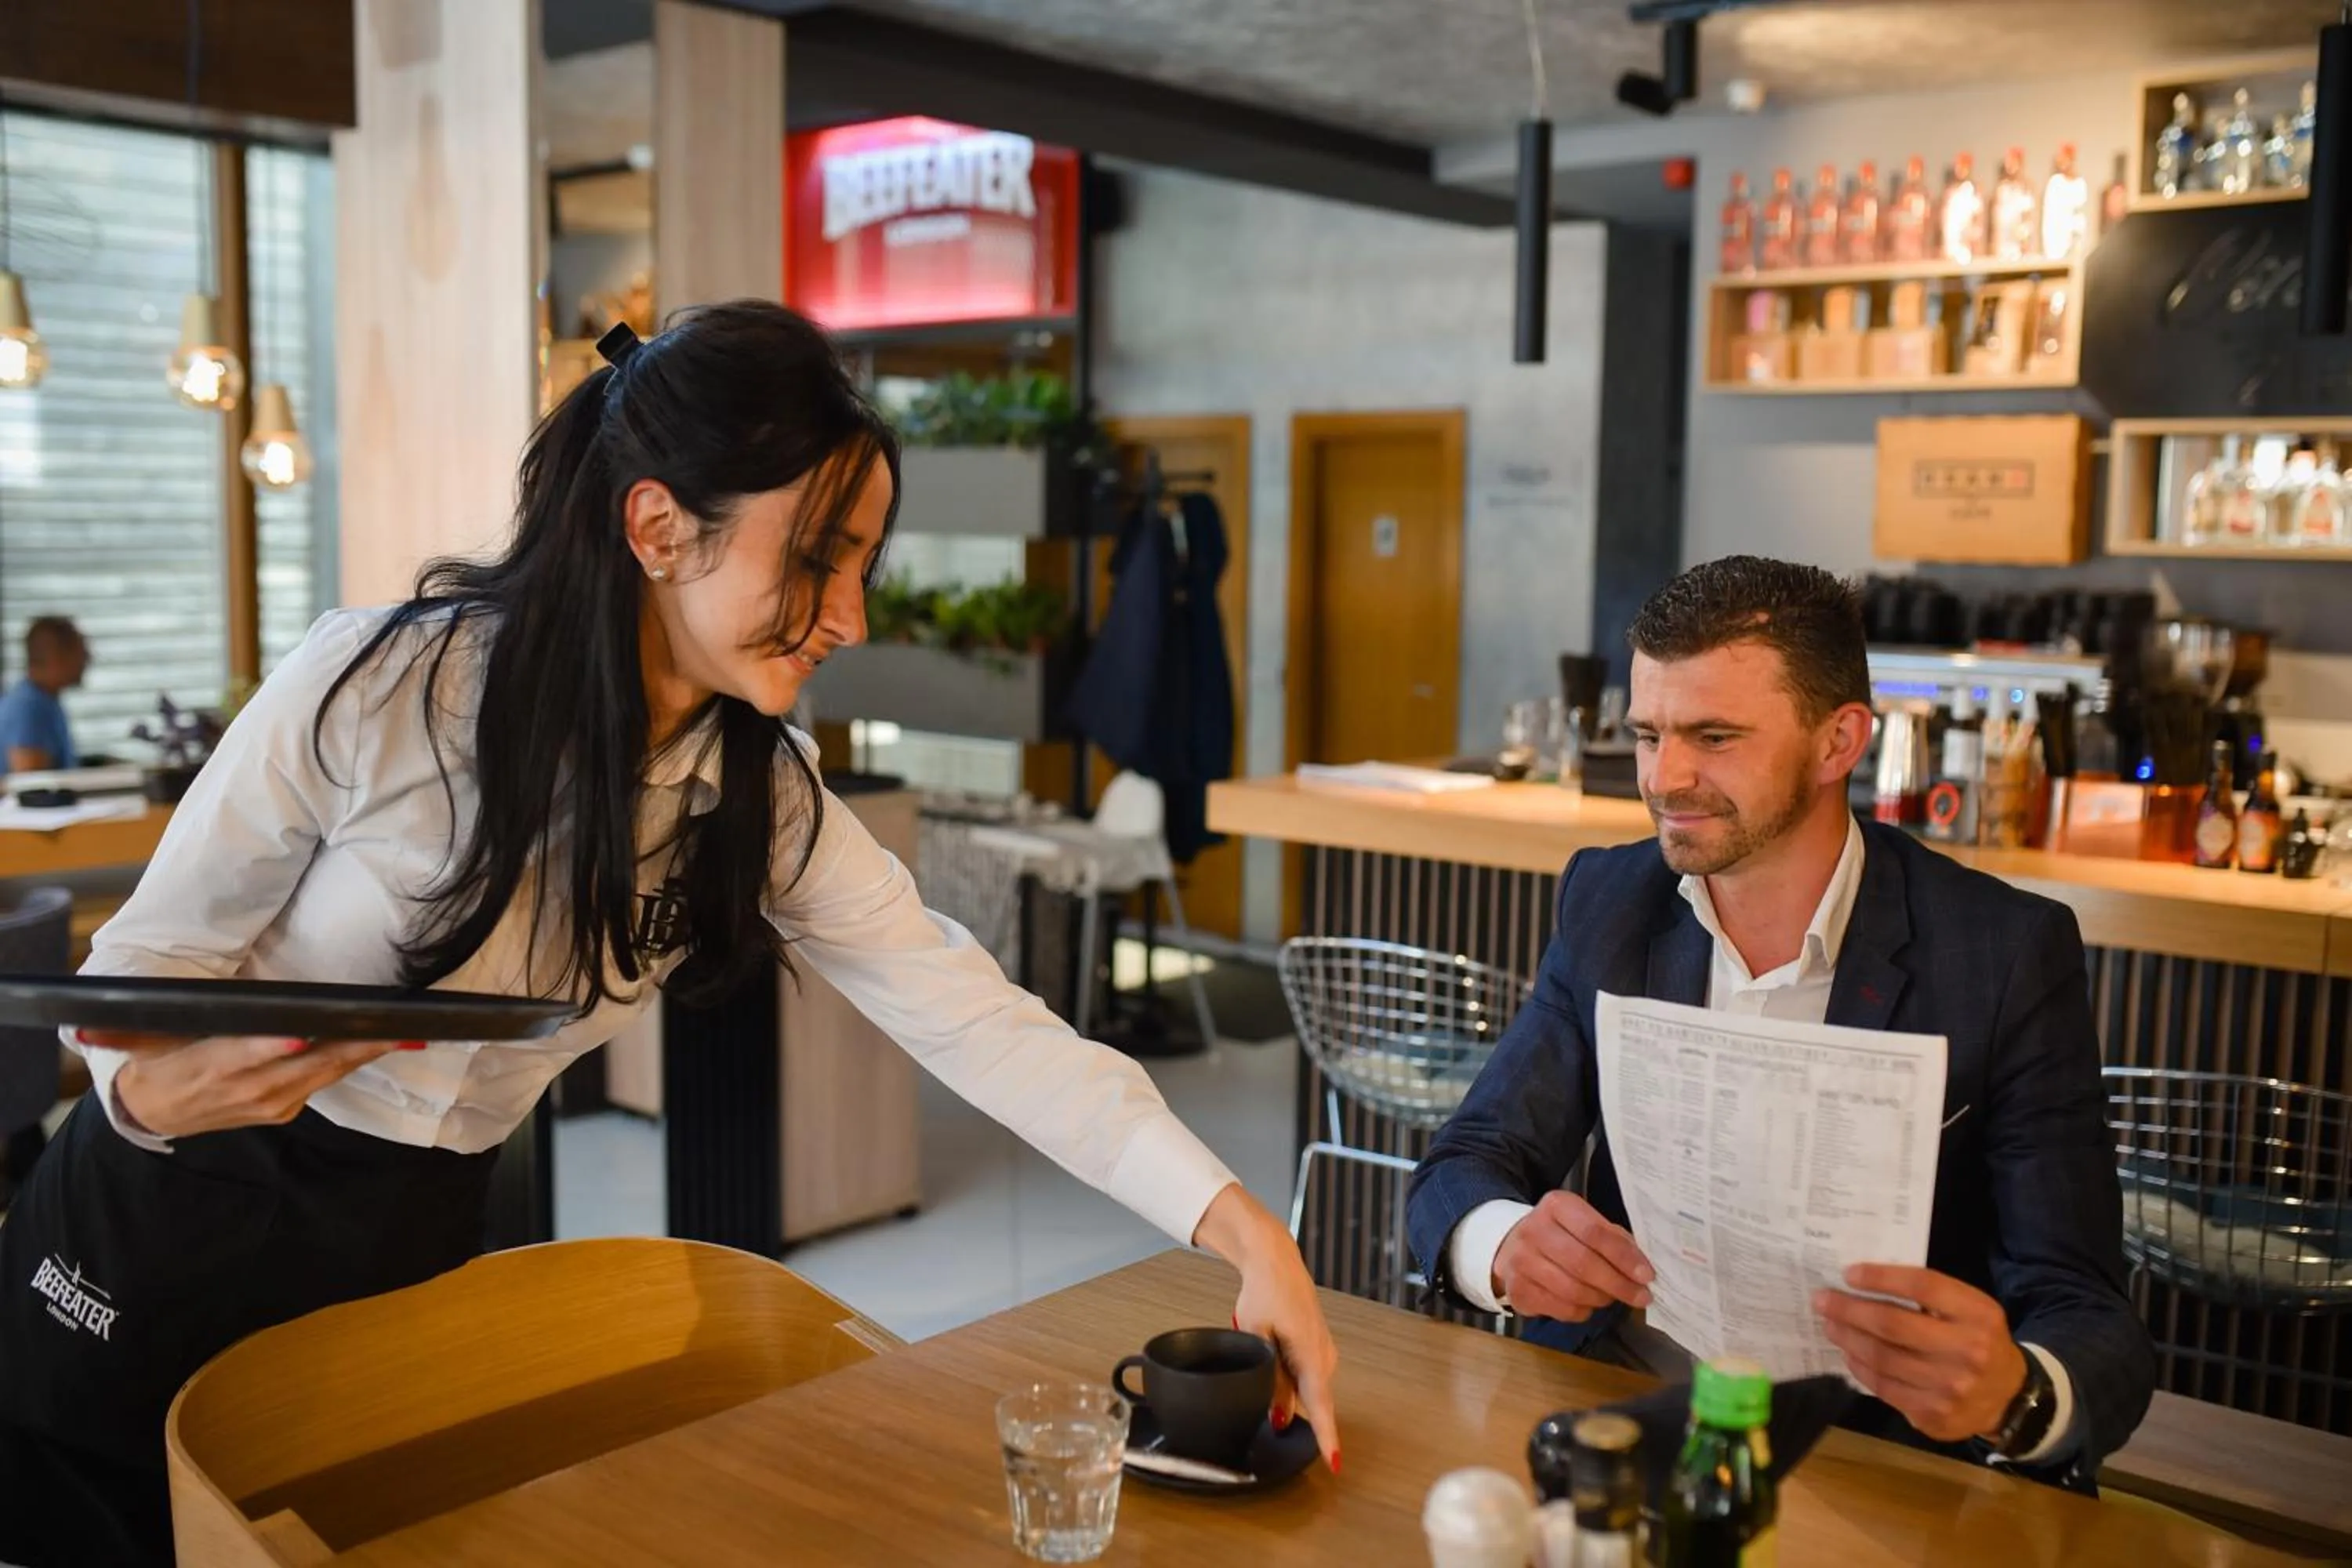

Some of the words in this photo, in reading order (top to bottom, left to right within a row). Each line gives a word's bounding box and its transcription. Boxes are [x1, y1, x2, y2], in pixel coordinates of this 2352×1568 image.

[822, 129, 1036, 244] BEEFEATER
[31, 1256, 116, 1341] BEEFEATER
[46, 1301, 79, 1331] LONDON
